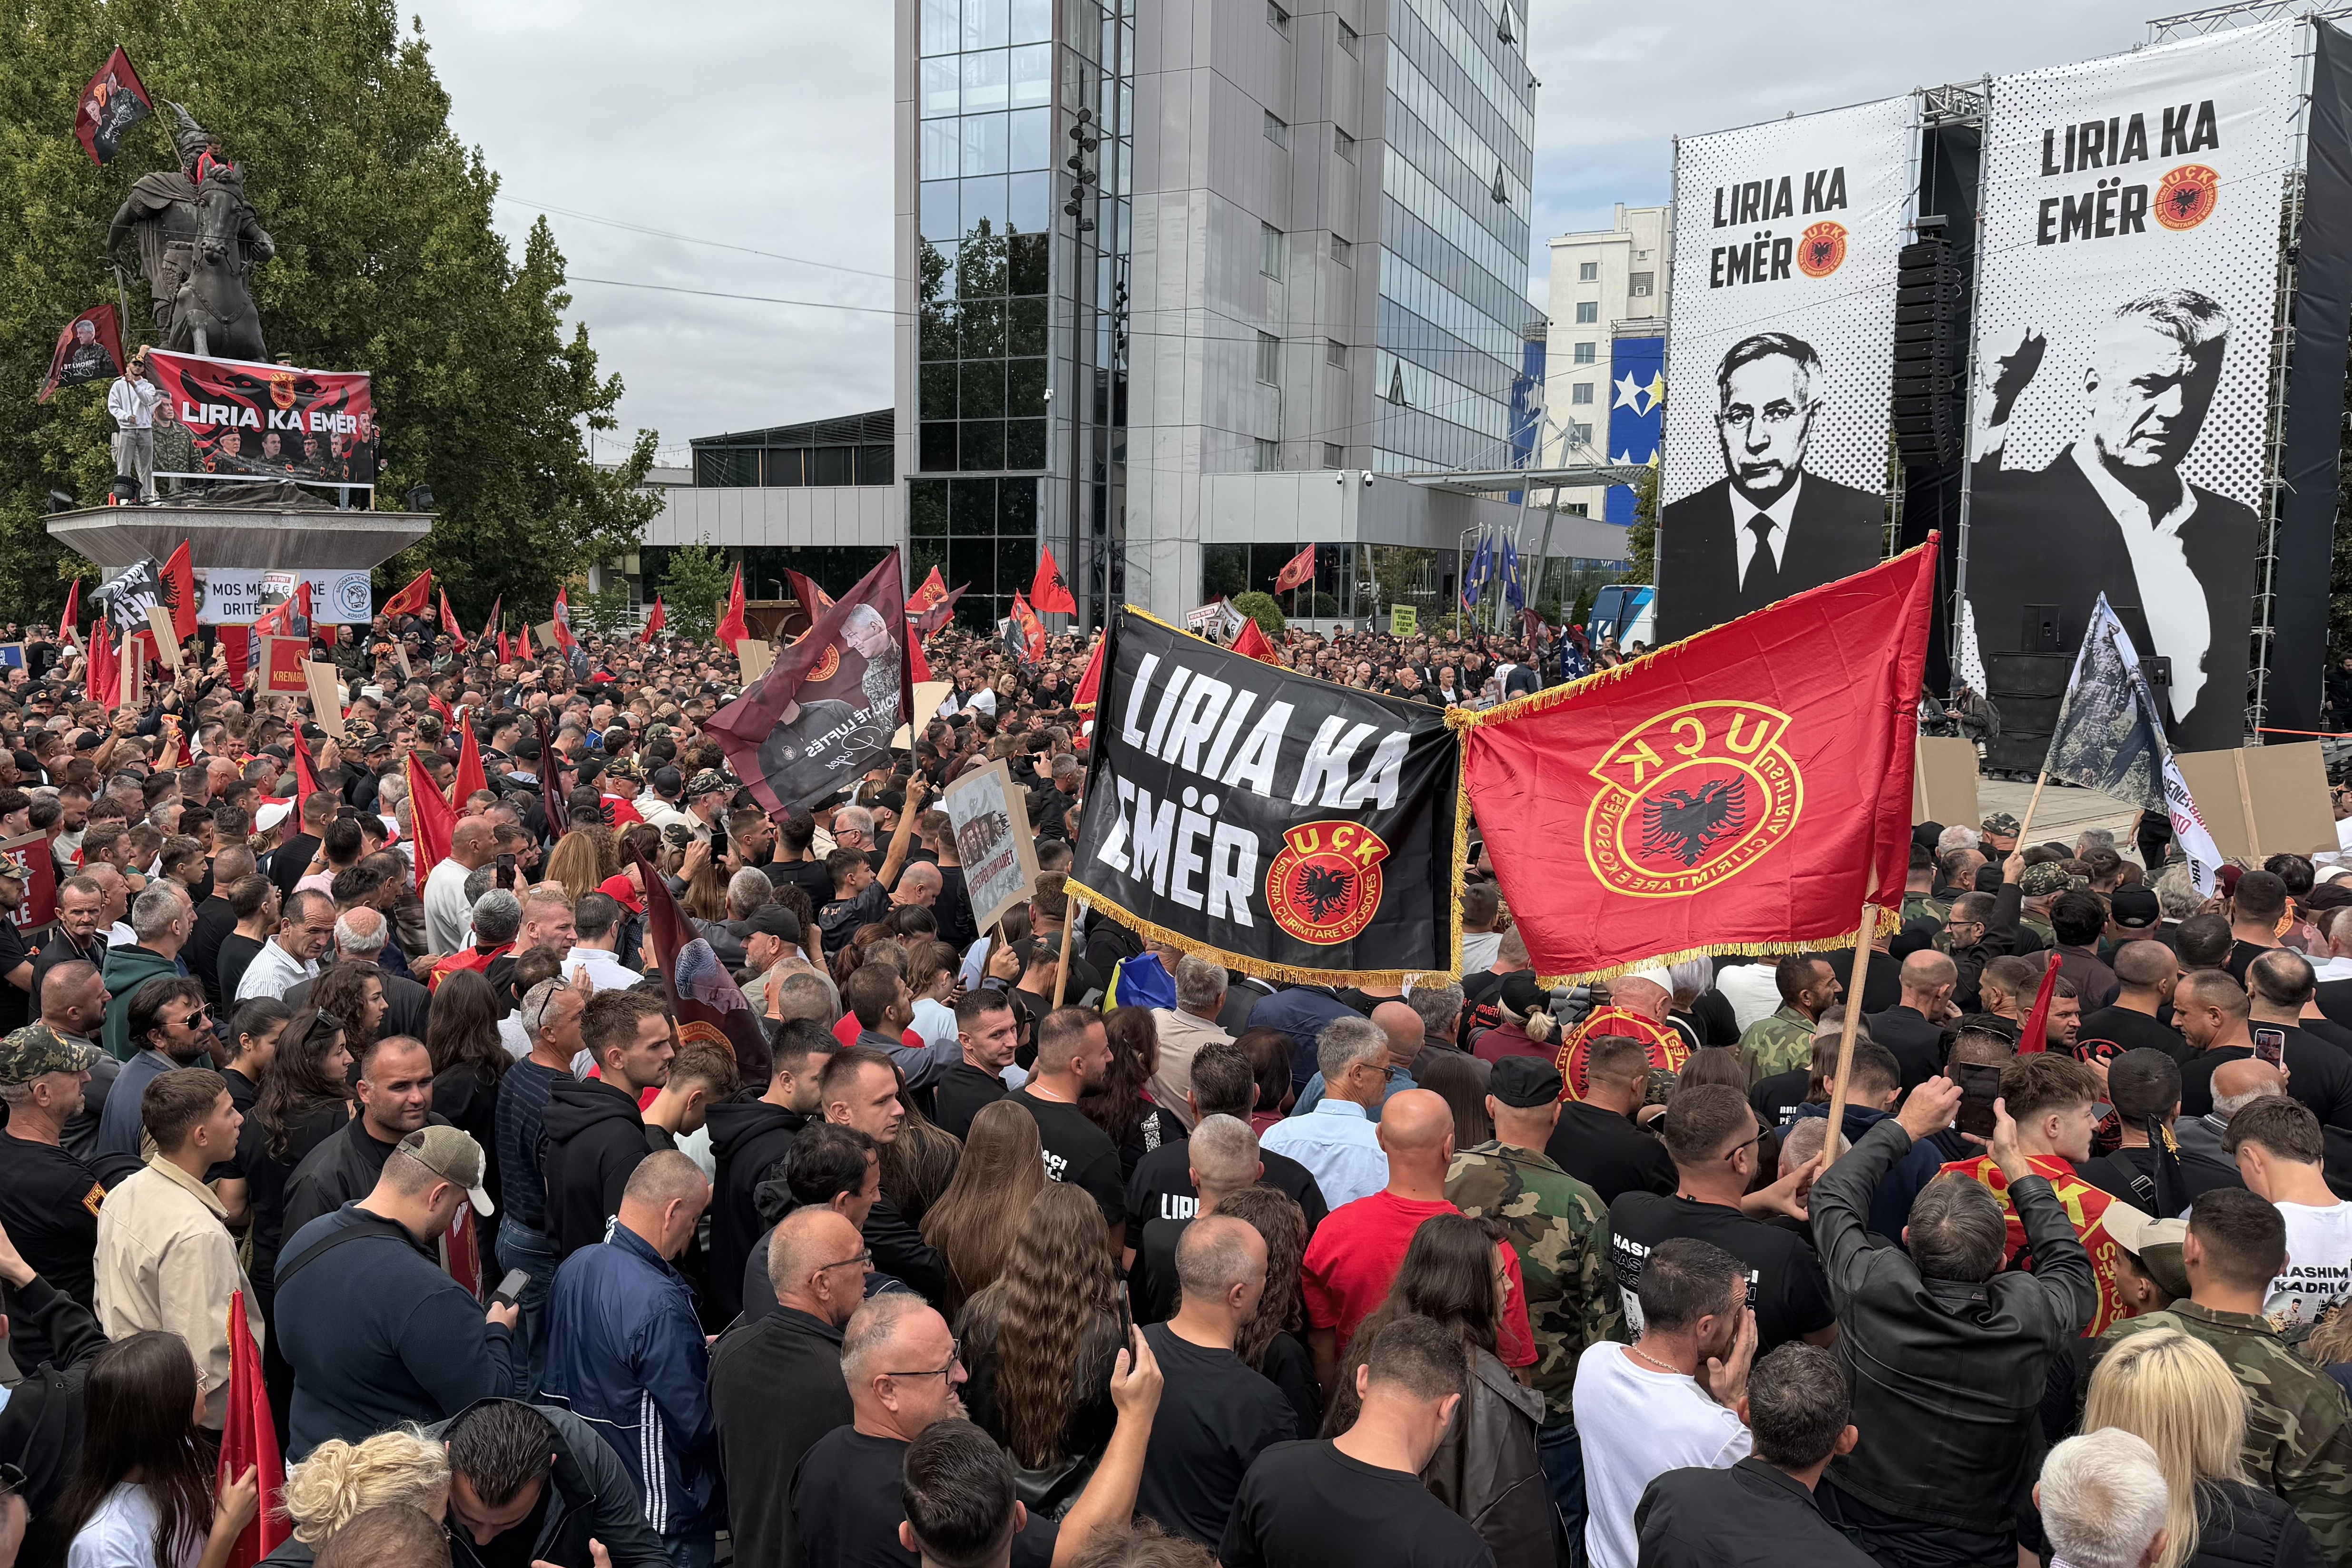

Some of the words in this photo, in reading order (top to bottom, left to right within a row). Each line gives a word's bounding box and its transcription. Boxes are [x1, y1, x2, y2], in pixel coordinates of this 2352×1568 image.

[2041, 113, 2149, 177] LIRIA
[2161, 100, 2219, 157] KA
[2168, 167, 2213, 184] UÇK
[1713, 176, 1793, 228] LIRIA
[1802, 167, 1848, 215] KA
[2037, 176, 2147, 246] EMËR
[1808, 223, 1843, 238] UÇK
[2160, 215, 2197, 228] ÇLIRIMTARE
[1710, 230, 1793, 289] EMËR
[182, 401, 261, 428] LIRIA
[268, 409, 305, 431] KA
[310, 410, 357, 434] EMËR
[213, 584, 244, 596] MOS
[1122, 652, 1295, 798] LIRIA
[1291, 715, 1412, 810] KA
[1097, 775, 1259, 928] EMËR
[1293, 826, 1384, 866] UÇK
[1271, 857, 1292, 905] USHTRIA
[1350, 873, 1376, 928] KOSOVËS
[1275, 906, 1341, 939] ÇLIRIMTARE
[1341, 923, 1353, 934] E
[2274, 1281, 2335, 1294] KADRI
